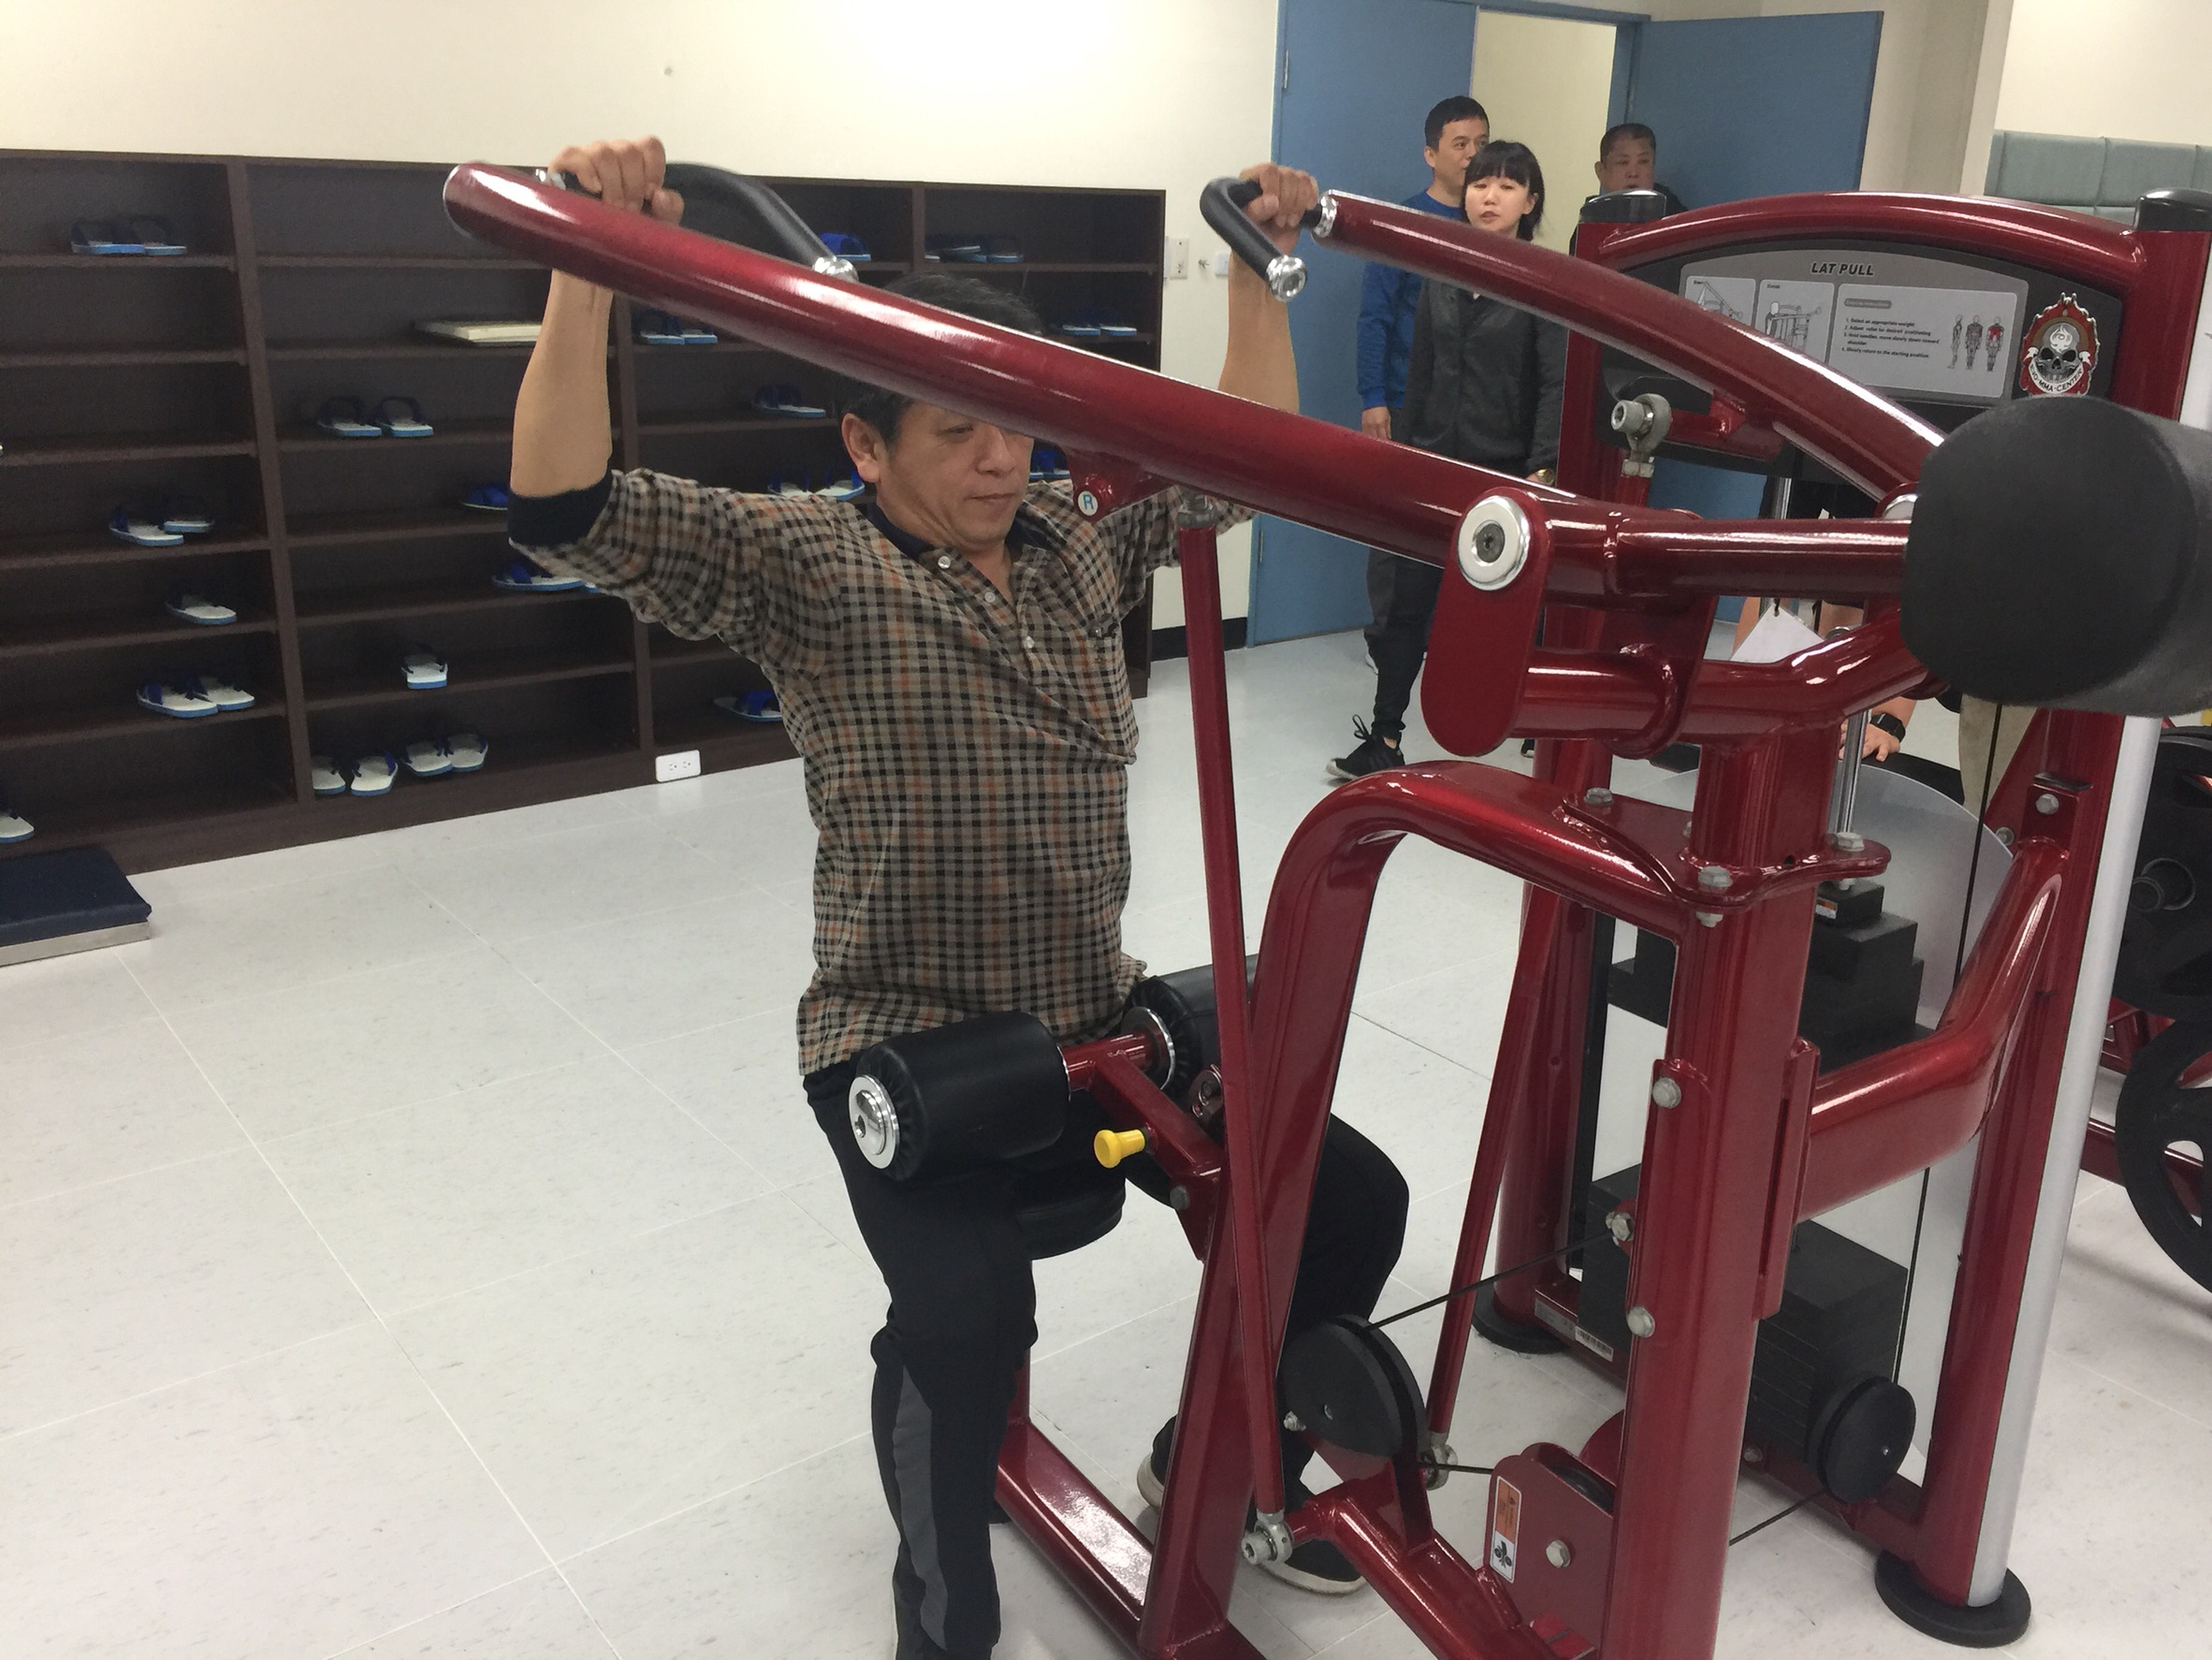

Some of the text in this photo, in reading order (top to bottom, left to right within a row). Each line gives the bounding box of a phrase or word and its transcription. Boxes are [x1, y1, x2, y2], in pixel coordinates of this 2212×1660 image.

[1811, 262, 1874, 276] LAT PULL
[2039, 380, 2054, 392] MMA
[2056, 368, 2083, 391] CENTER
[1083, 494, 1094, 510] R
